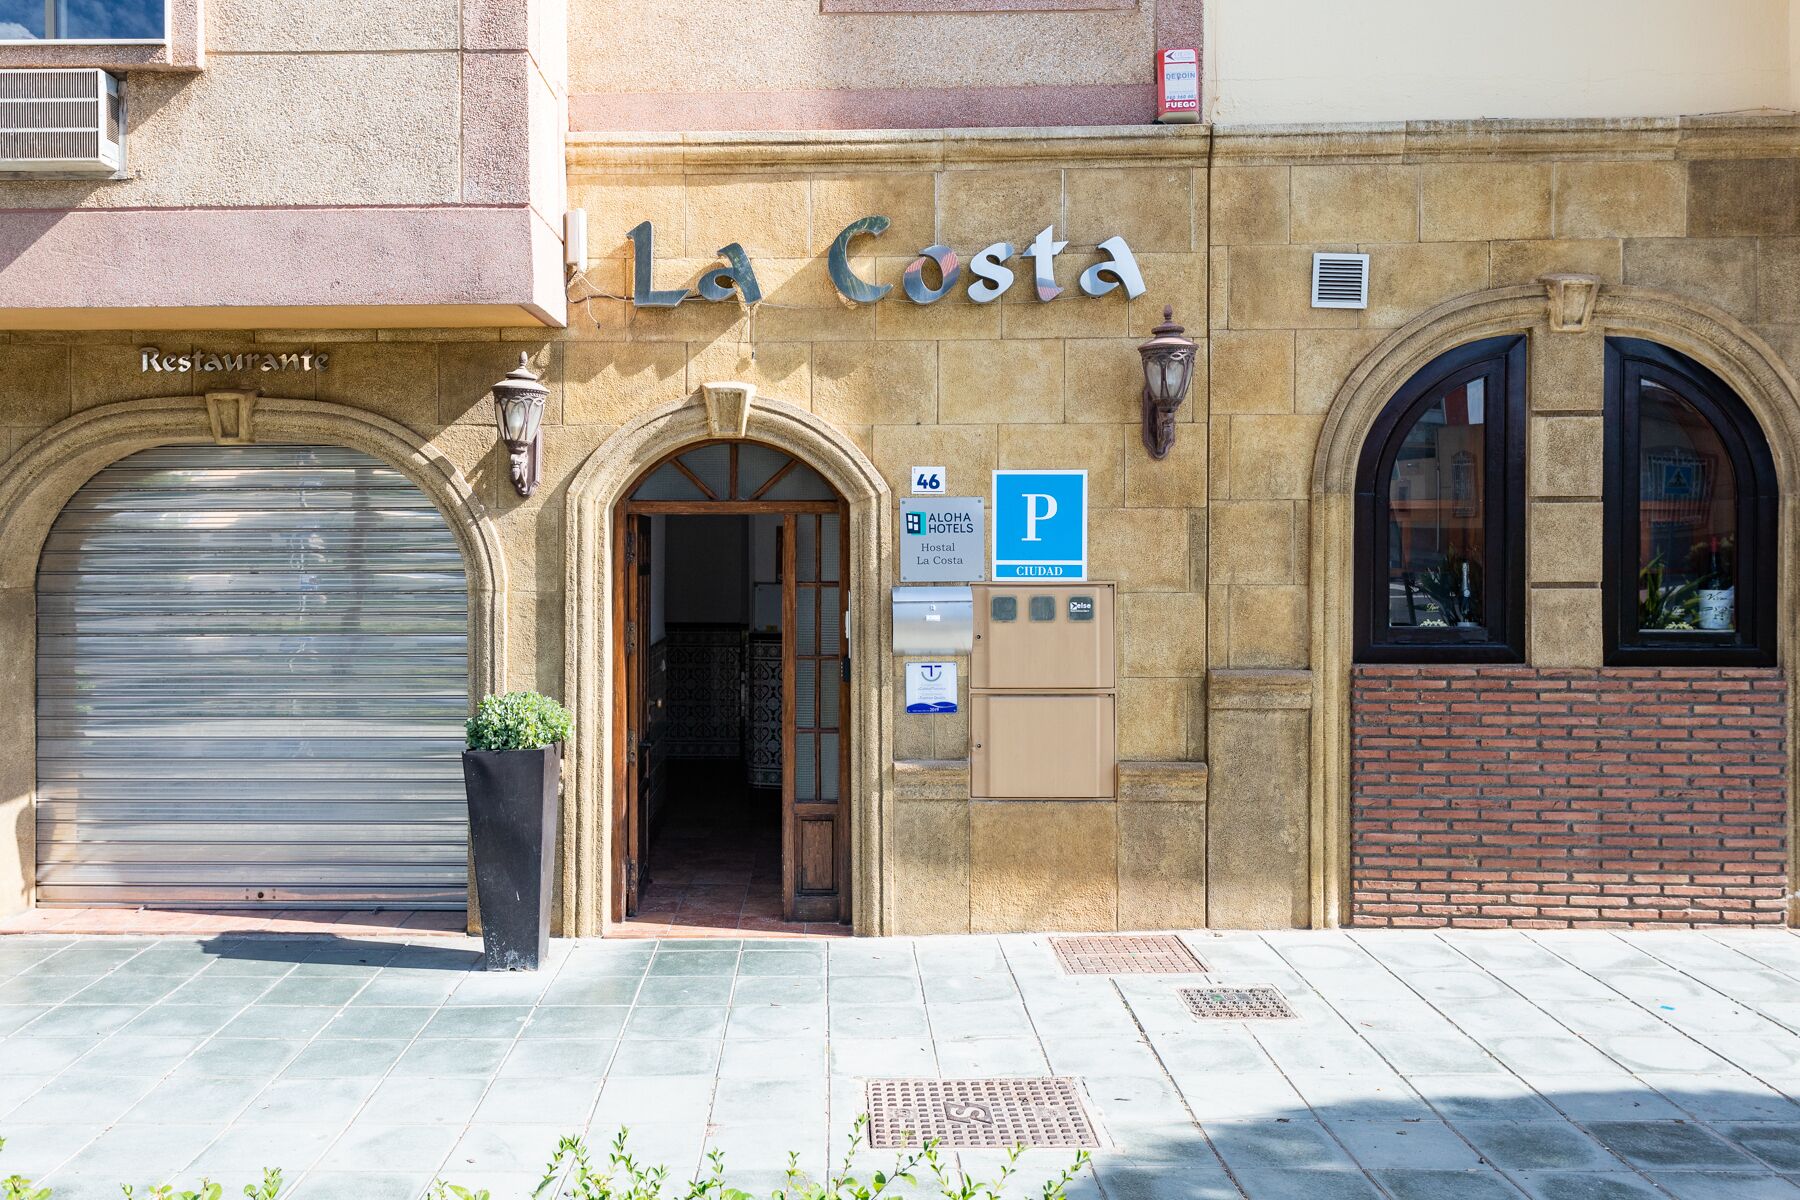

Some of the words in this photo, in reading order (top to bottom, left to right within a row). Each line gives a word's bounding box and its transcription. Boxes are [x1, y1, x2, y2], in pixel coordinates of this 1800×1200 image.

[1166, 101, 1196, 109] FUEGO
[626, 220, 763, 308] La
[828, 215, 1148, 305] Costa
[140, 346, 330, 373] Restaurante
[916, 473, 941, 490] 46
[928, 512, 972, 523] ALOHA
[1021, 493, 1058, 542] P
[928, 523, 974, 534] HOTELS
[920, 542, 956, 553] Hostal
[916, 556, 930, 566] La
[933, 555, 964, 566] Costa
[1016, 565, 1063, 577] CIUDAD
